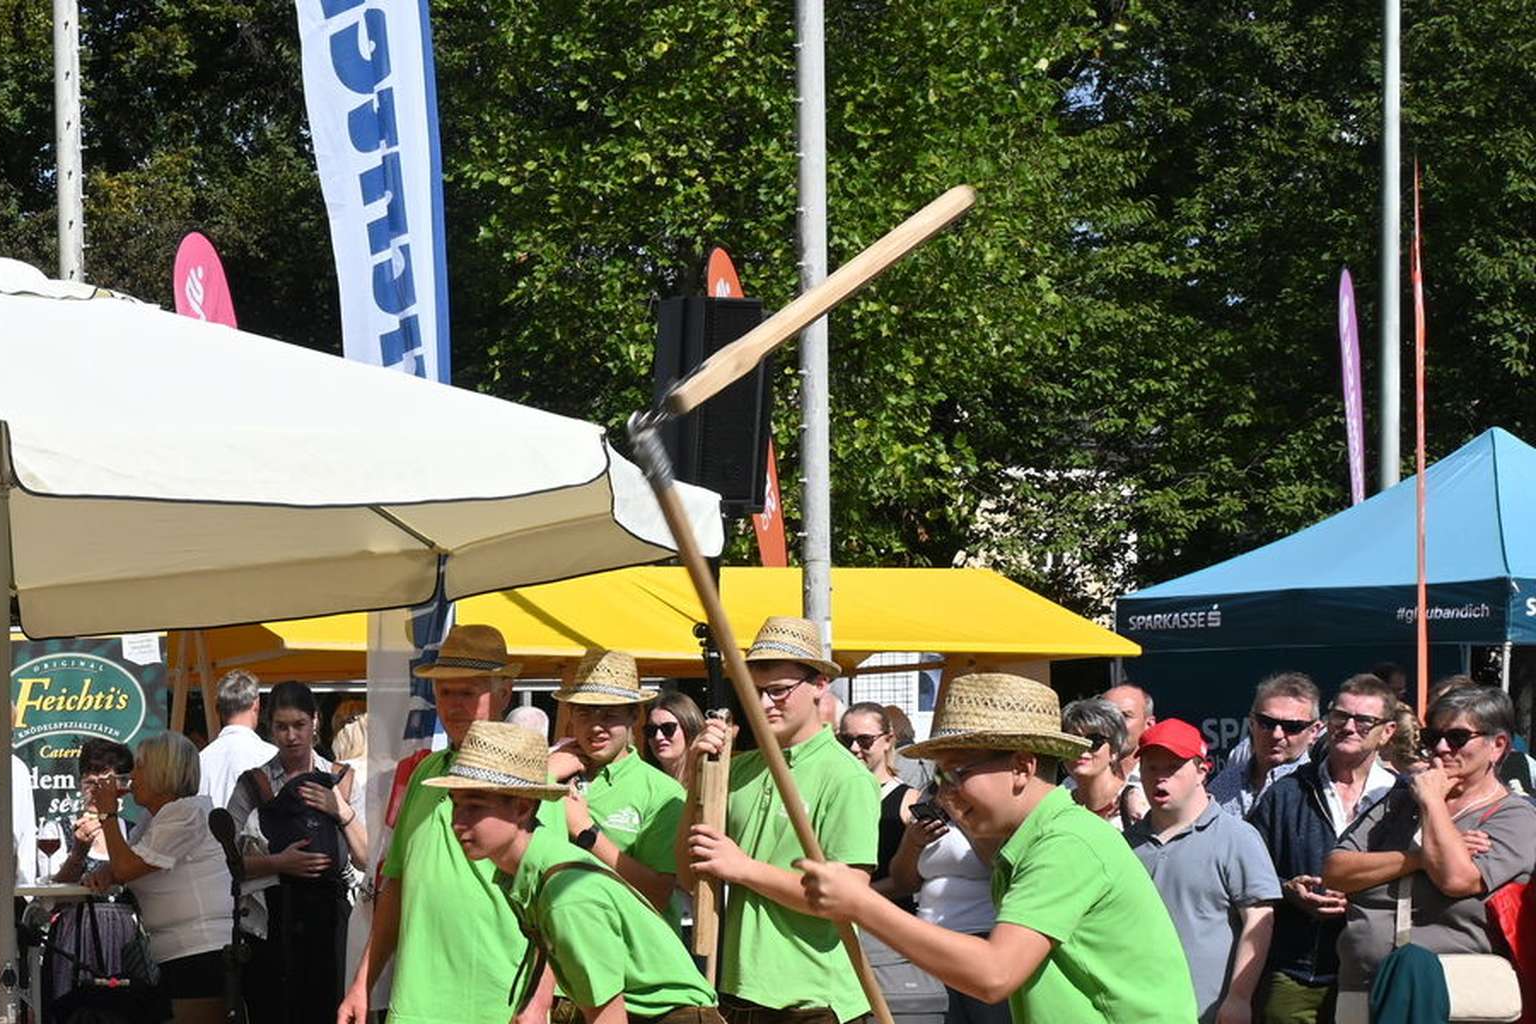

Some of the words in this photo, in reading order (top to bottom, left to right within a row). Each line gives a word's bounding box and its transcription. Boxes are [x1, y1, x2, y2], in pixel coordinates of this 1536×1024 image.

[1128, 611, 1206, 631] SPARKASSE
[32, 658, 105, 673] ORIGINAL
[14, 677, 129, 729] Feichti's
[39, 745, 83, 759] Cateri
